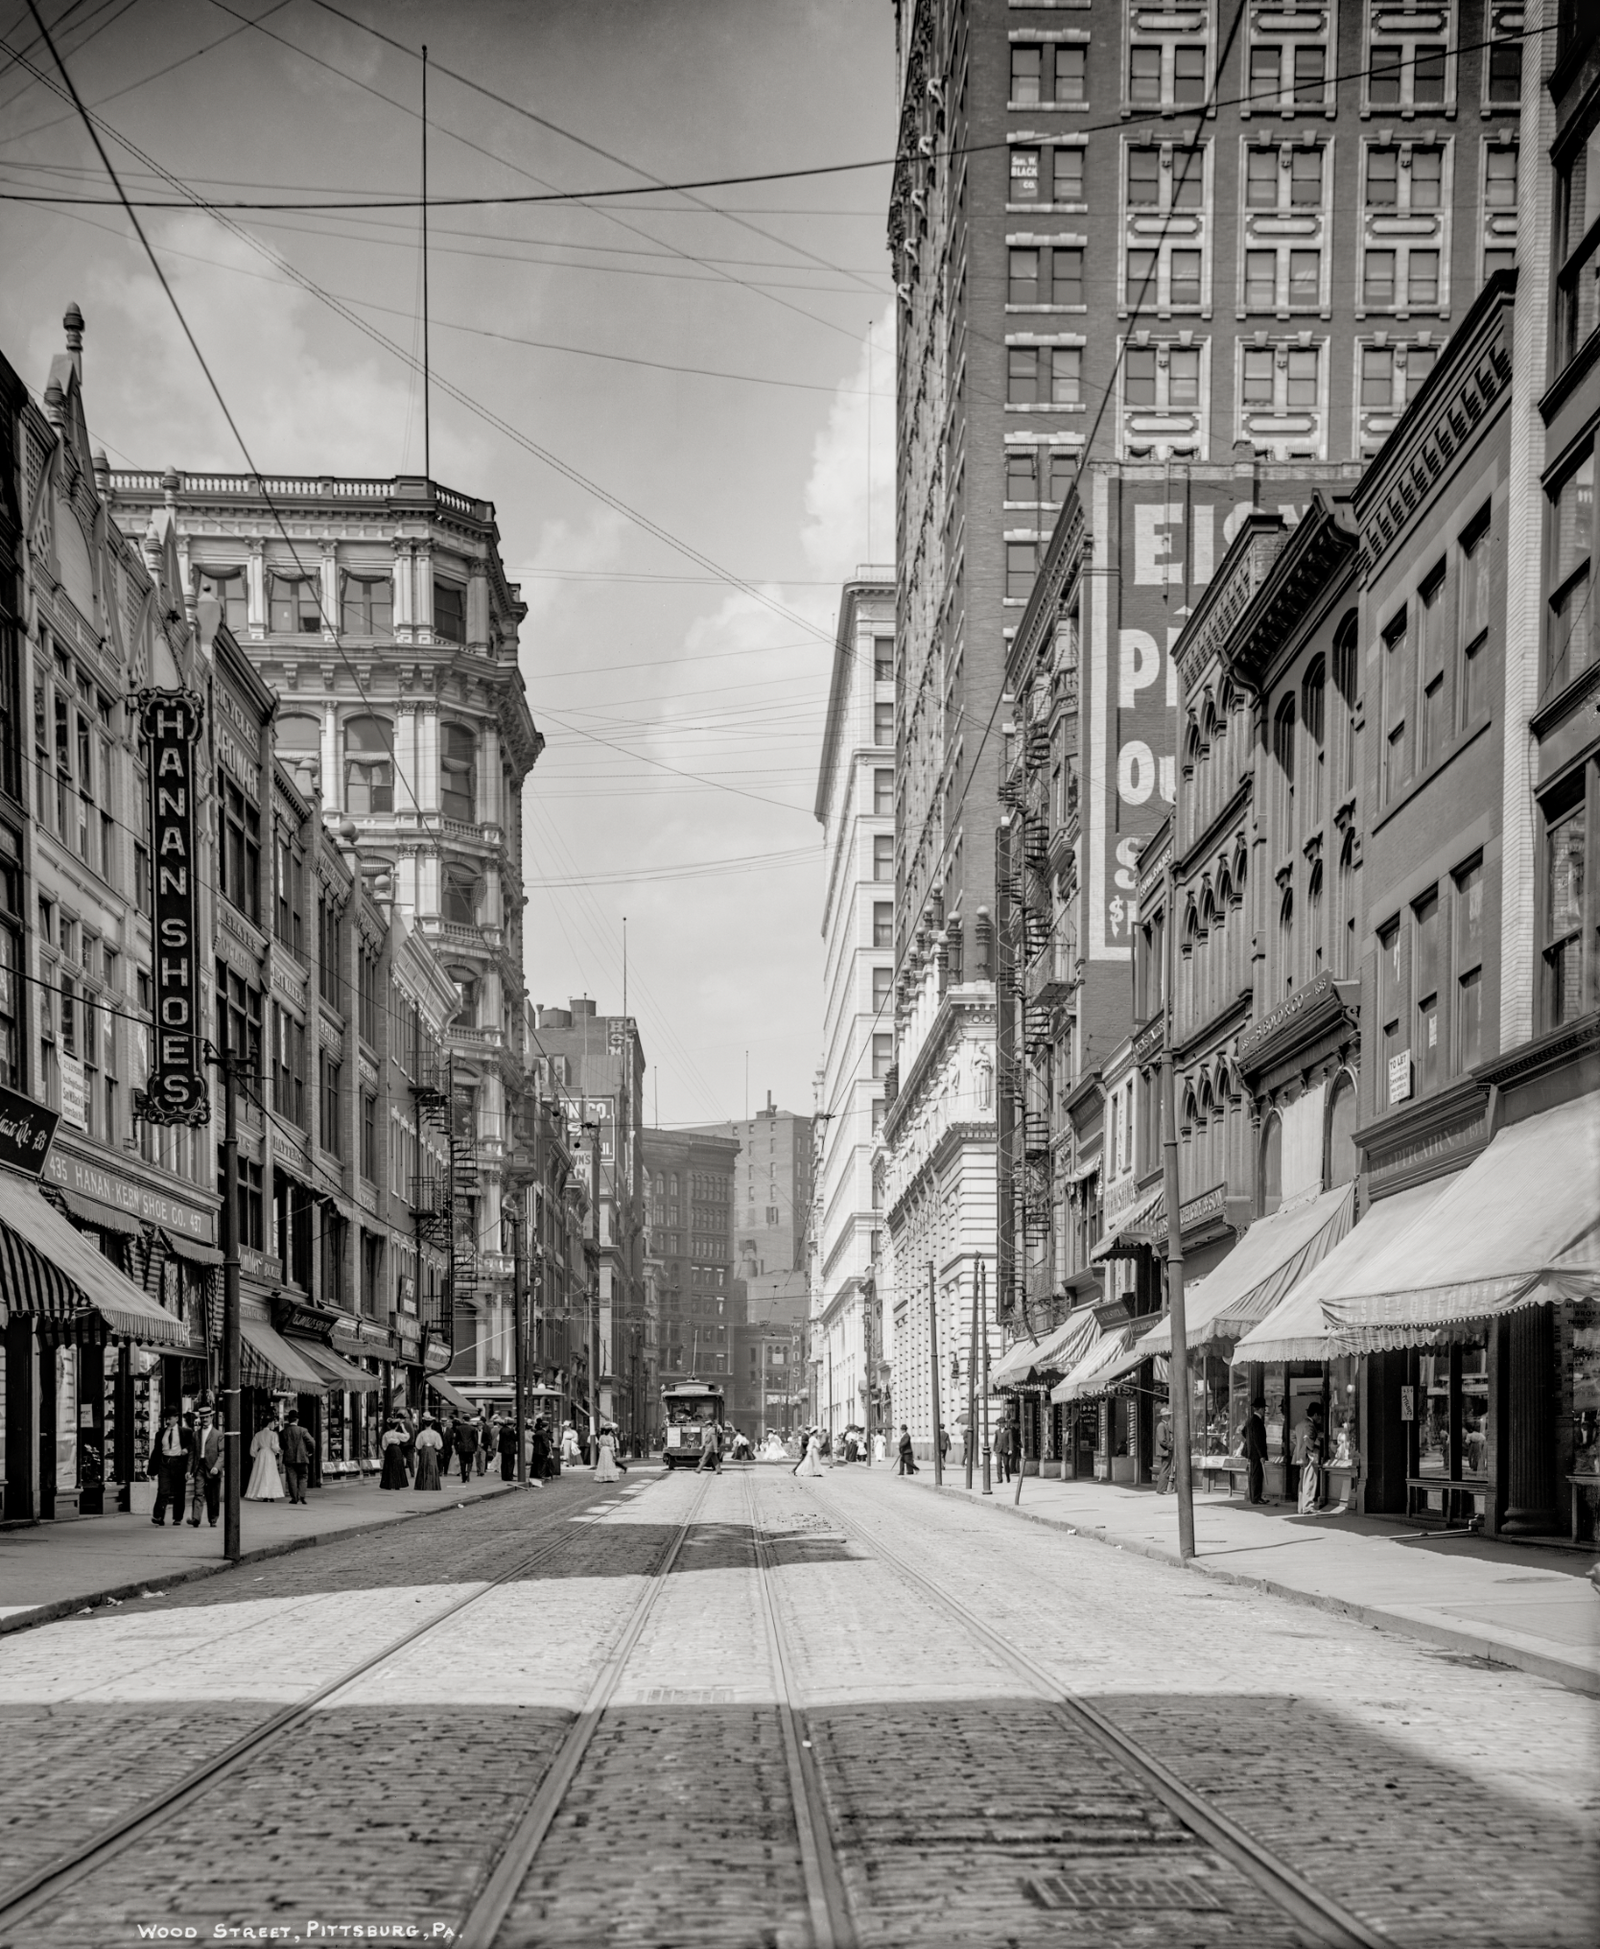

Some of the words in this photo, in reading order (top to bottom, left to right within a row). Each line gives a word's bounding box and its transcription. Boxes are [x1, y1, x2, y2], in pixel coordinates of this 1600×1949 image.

[1011, 167, 1037, 176] BLACK
[157, 709, 187, 895] HANAN
[161, 919, 189, 1101] SHOES
[1390, 1060, 1396, 1070] TO
[1397, 1054, 1406, 1066] LET
[49, 1155, 68, 1181] 435
[142, 1194, 168, 1221] SHOE
[171, 1206, 187, 1228] CO.
